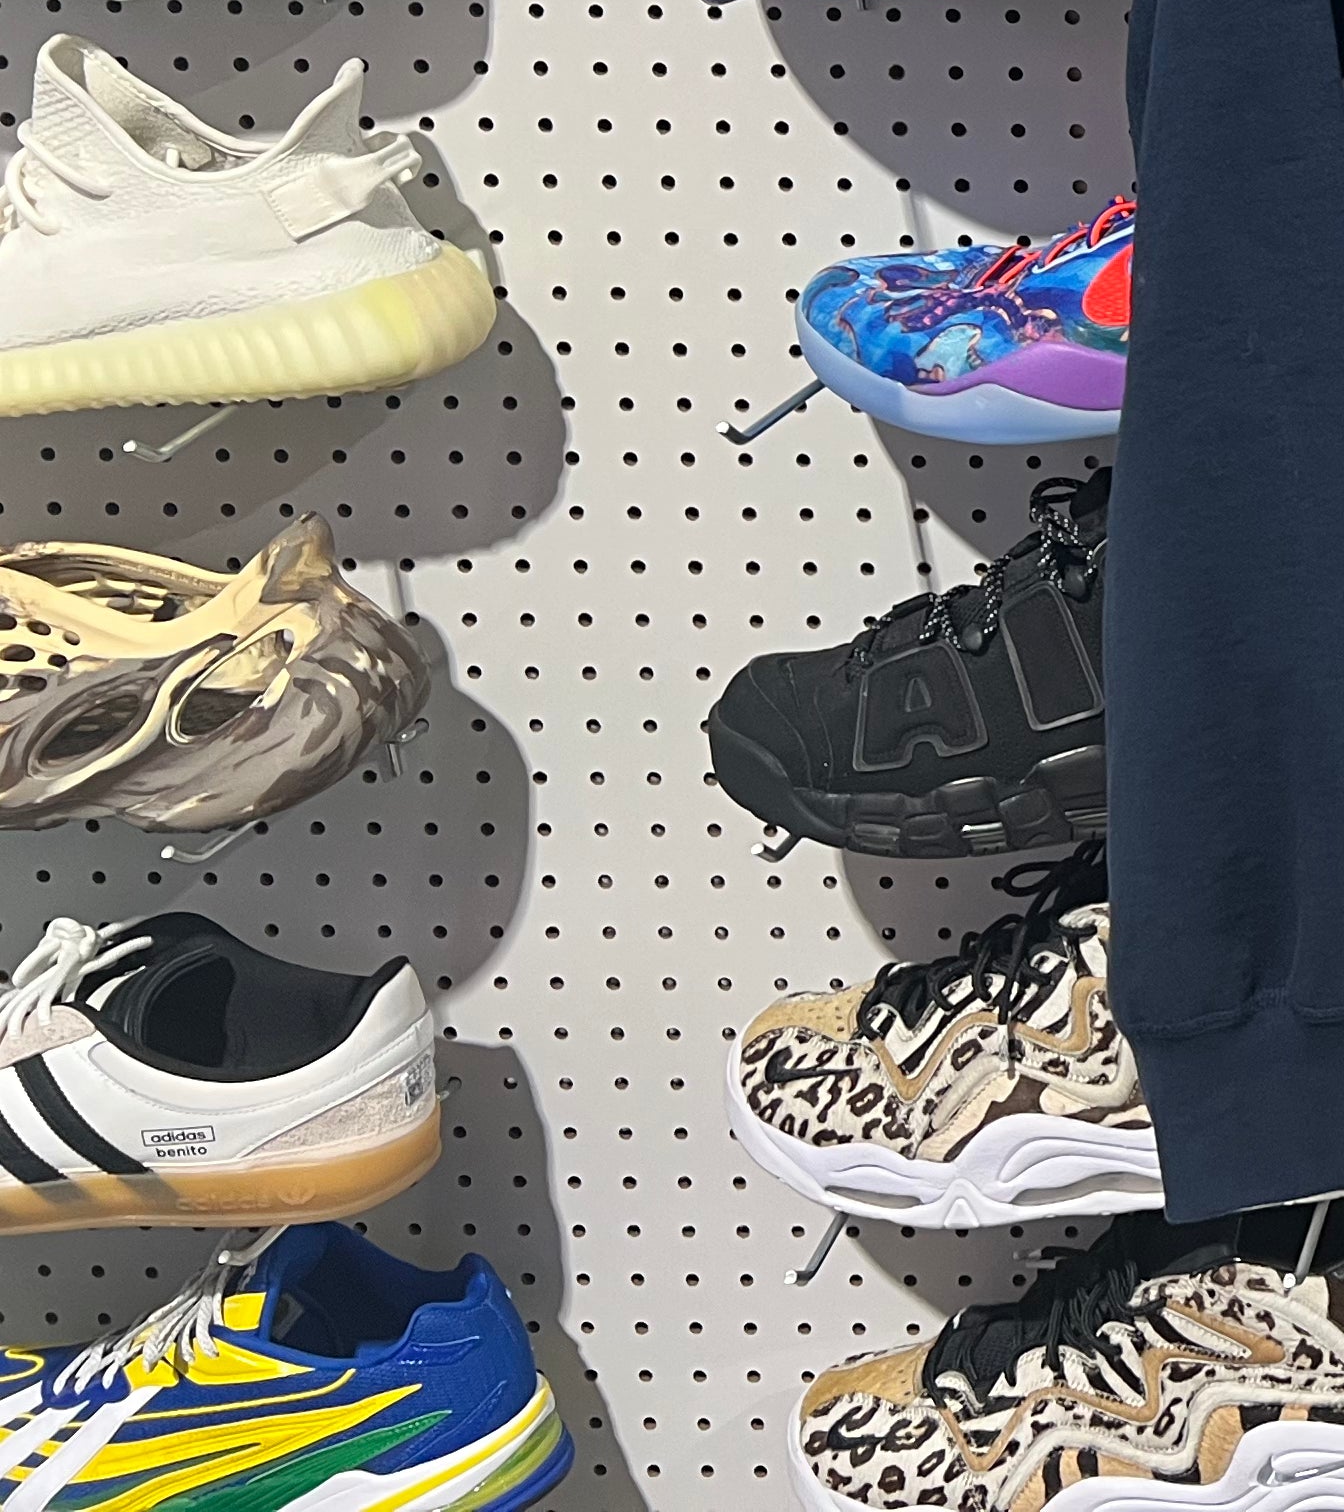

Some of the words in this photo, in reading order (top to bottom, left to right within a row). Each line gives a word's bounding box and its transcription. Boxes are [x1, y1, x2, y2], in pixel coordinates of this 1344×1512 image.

[853, 540, 1106, 772] AI
[150, 1130, 207, 1143] adidas
[155, 1145, 208, 1158] benito
